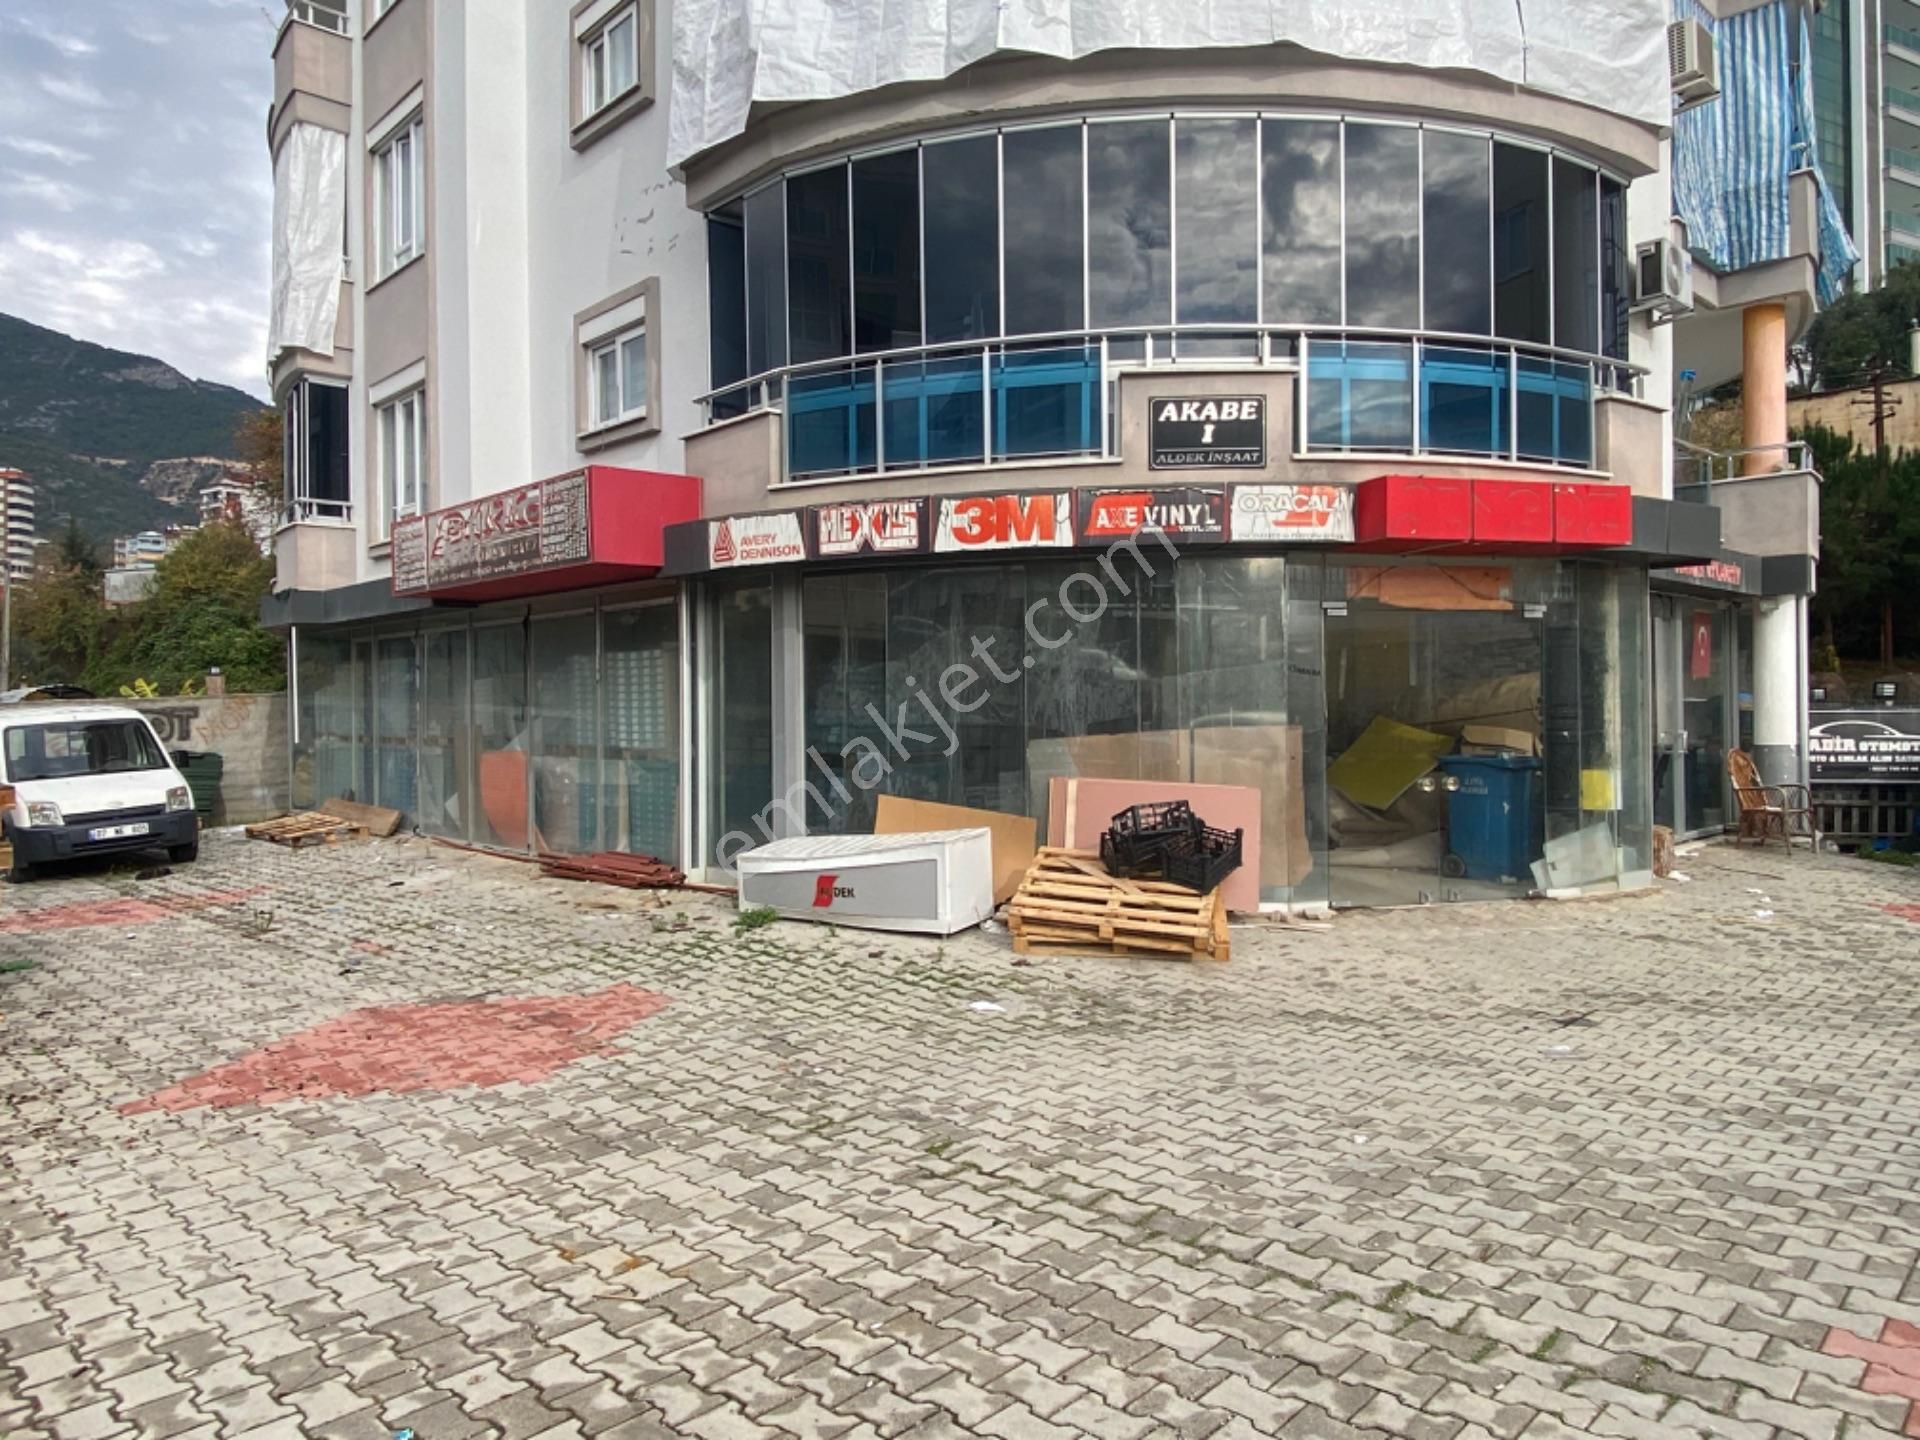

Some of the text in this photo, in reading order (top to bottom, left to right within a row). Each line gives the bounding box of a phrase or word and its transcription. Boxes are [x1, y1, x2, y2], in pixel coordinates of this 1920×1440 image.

[1158, 401, 1259, 421] AKABE
[1156, 454, 1204, 464] ALDEK
[1238, 493, 1336, 513] ORACAL
[950, 495, 1056, 543] 3M
[740, 533, 778, 546] AVERY
[740, 546, 800, 560] DENNISON
